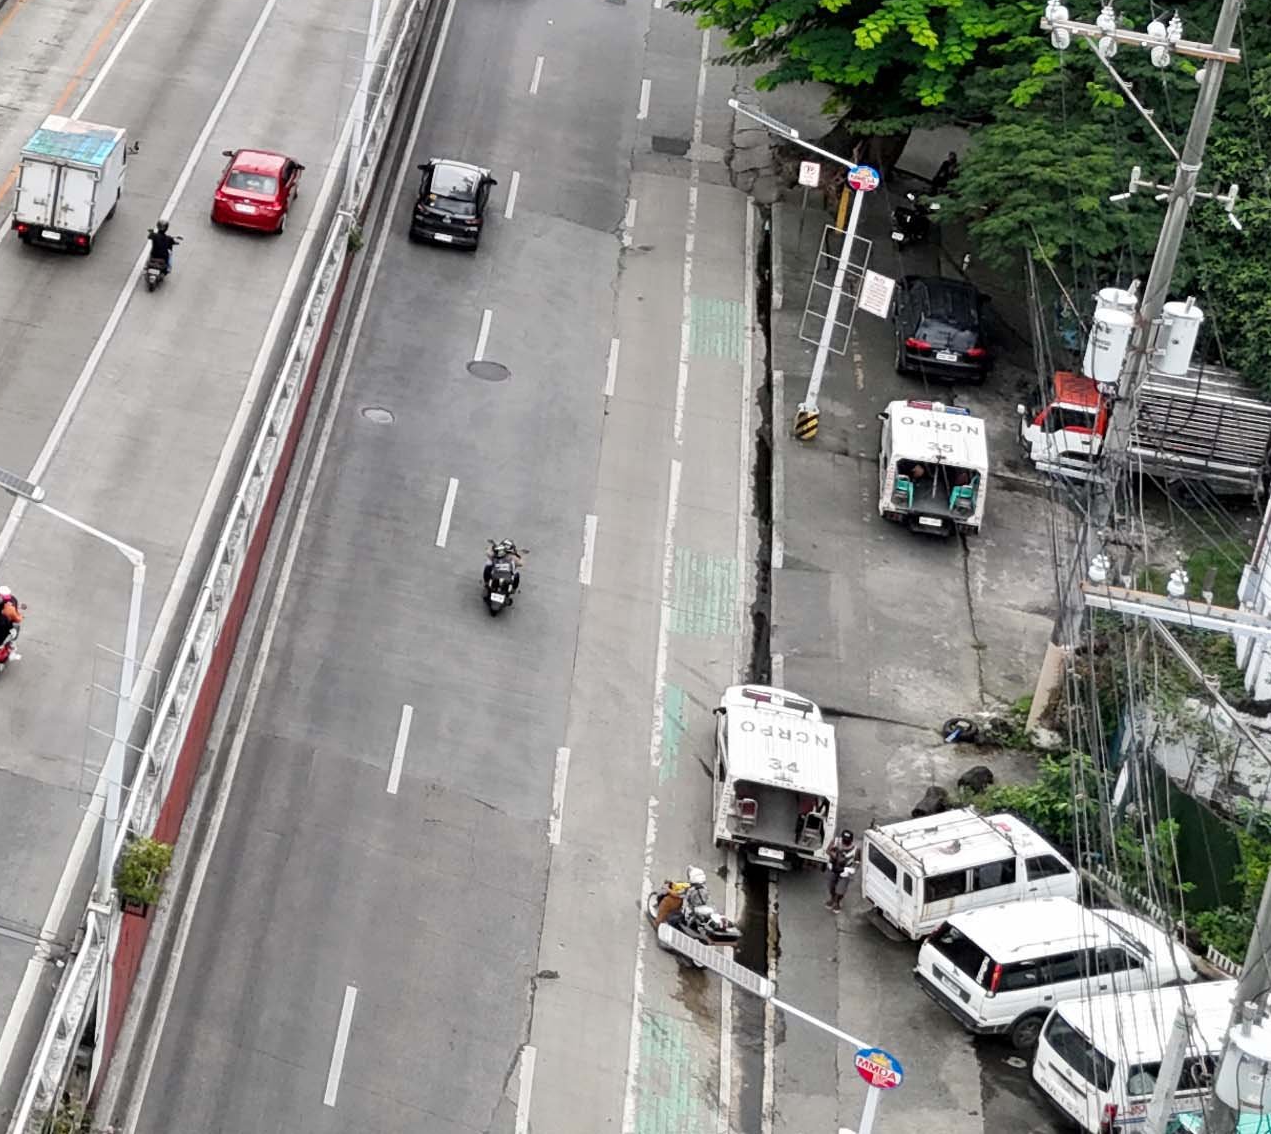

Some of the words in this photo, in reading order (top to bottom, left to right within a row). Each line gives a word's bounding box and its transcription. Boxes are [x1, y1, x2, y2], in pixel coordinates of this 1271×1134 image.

[900, 416, 979, 436] NCRPO
[740, 720, 829, 749] NCRPO
[768, 757, 800, 774] 34
[857, 1057, 897, 1083] MMDA
